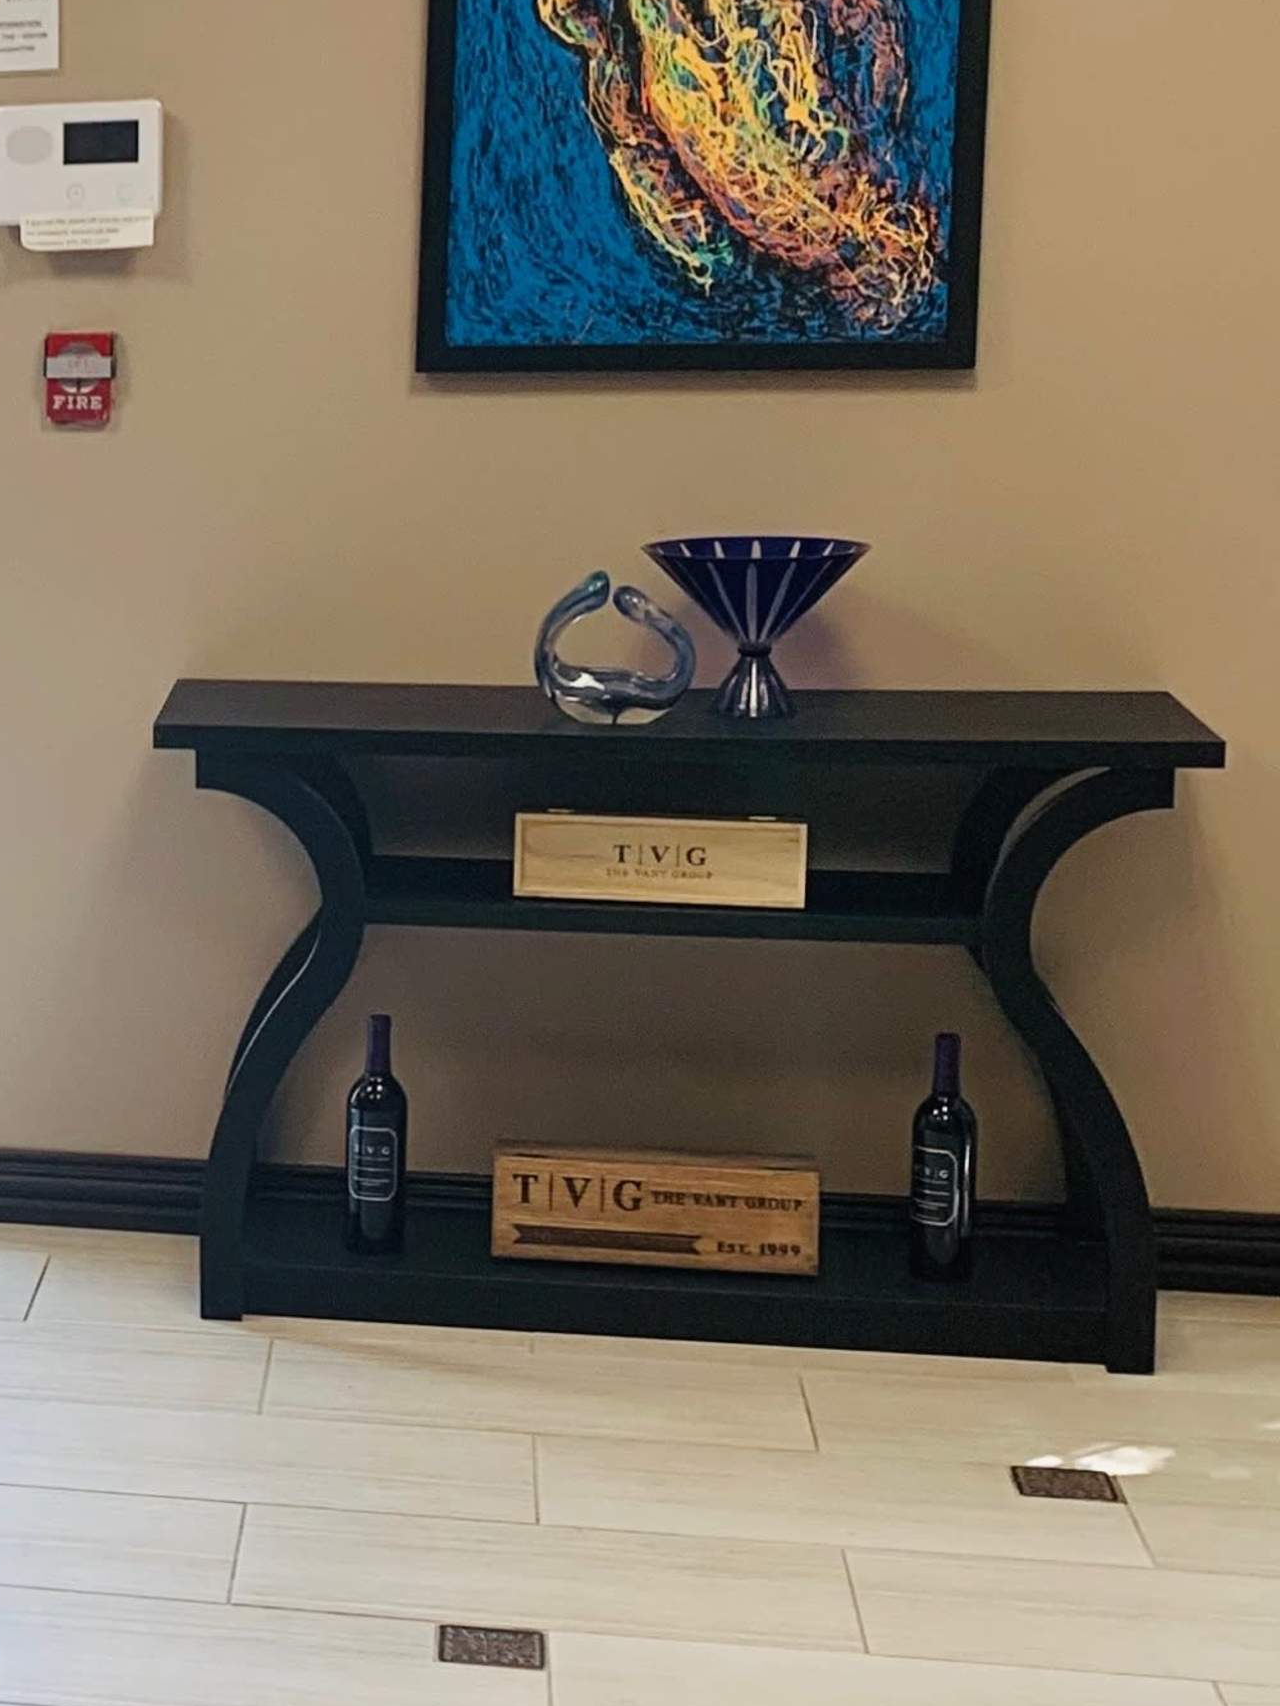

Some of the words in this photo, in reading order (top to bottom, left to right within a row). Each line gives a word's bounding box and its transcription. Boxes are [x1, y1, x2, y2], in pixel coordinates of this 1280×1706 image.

[52, 394, 103, 410] FIRE
[652, 1190, 686, 1205] THE
[744, 1195, 803, 1211] GROUP
